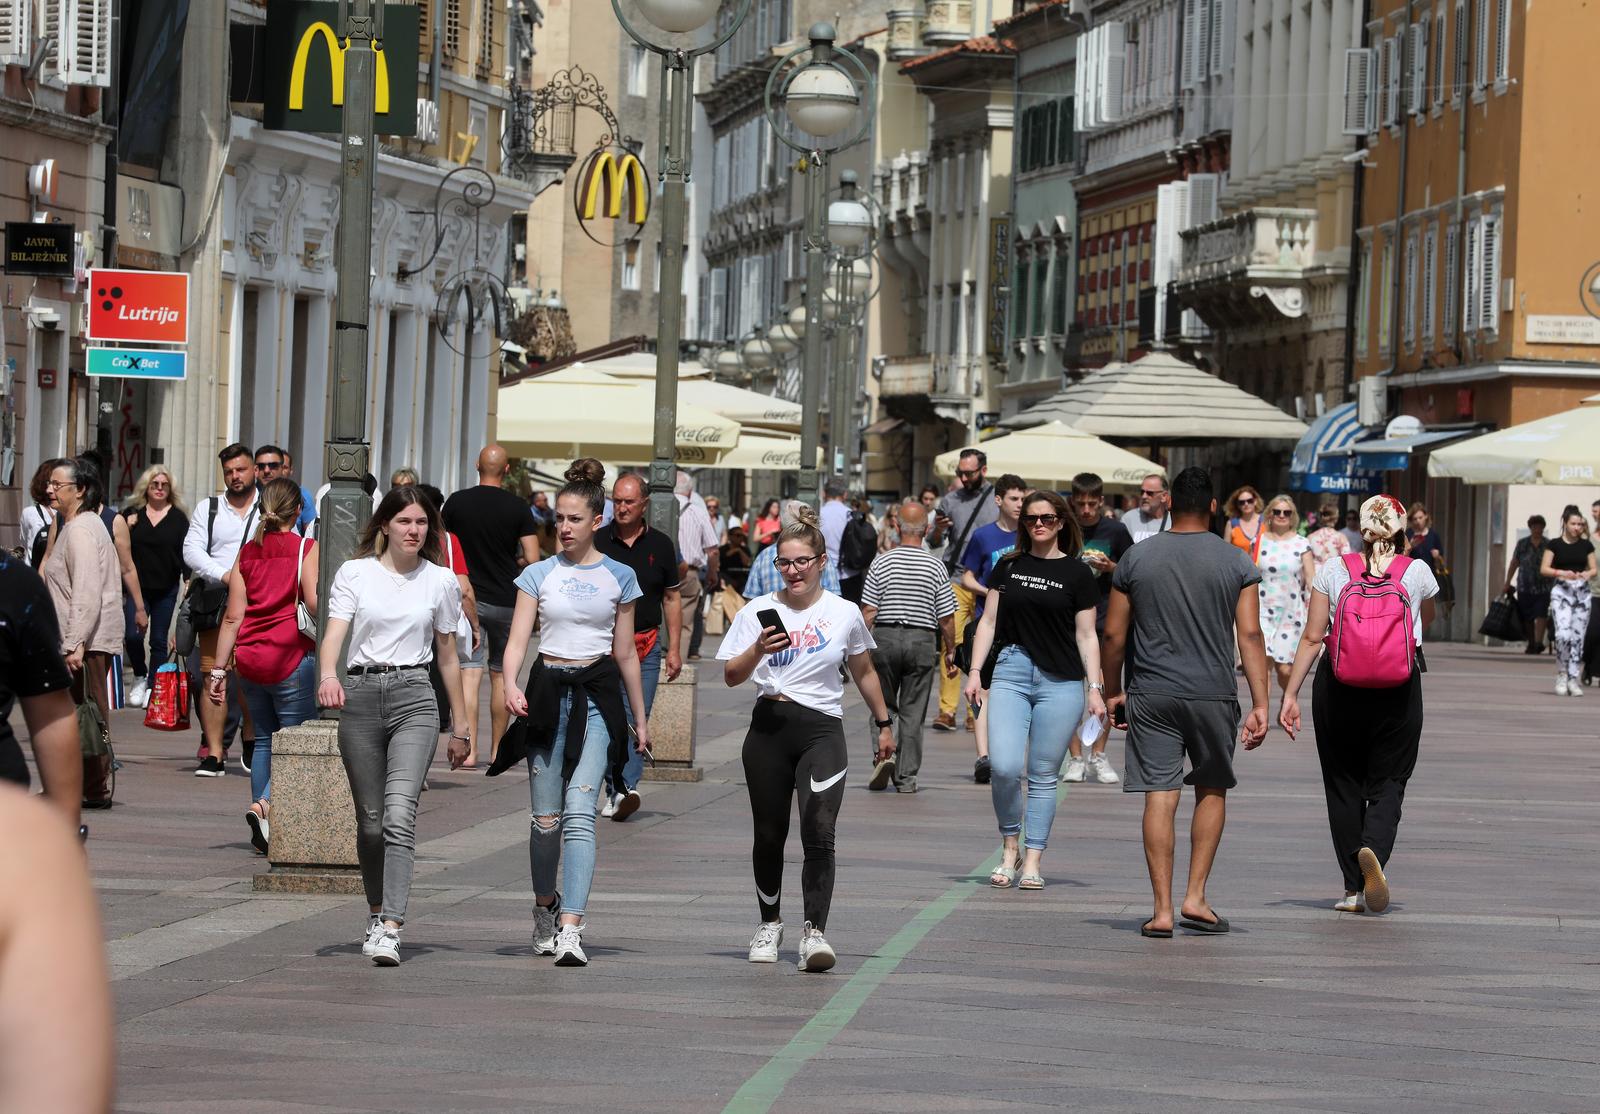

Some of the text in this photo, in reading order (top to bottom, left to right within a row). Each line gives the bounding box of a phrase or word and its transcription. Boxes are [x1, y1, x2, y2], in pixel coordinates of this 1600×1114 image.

[24, 237, 56, 247] JAVNI
[11, 252, 68, 263] BILJEŽNIK
[118, 305, 179, 325] Lutrija
[112, 356, 160, 370] CroXBet
[1320, 476, 1369, 491] ZLATAR
[1010, 573, 1064, 589] SOMETIMES LESS
[1029, 582, 1048, 591] MORE
